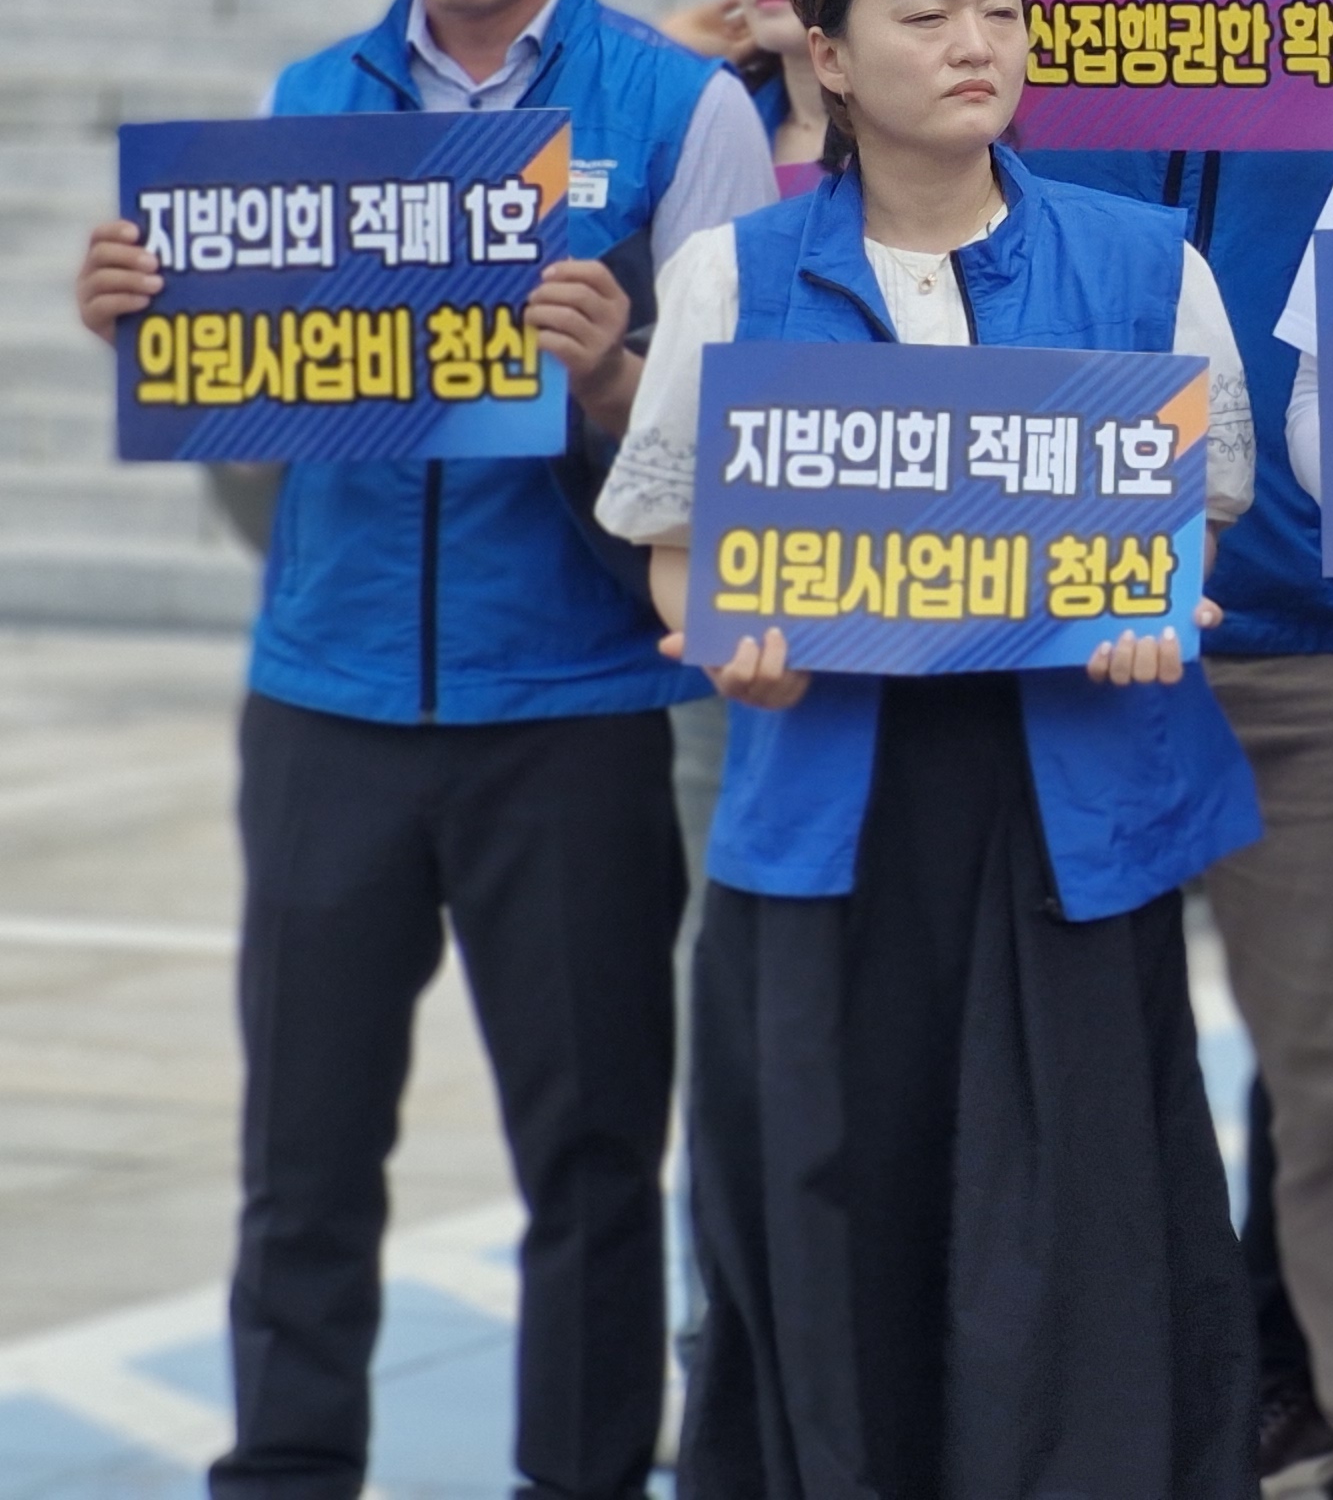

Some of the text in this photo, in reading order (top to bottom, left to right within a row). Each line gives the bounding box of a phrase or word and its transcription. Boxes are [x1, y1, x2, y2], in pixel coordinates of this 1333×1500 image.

[138, 179, 539, 270] 지방의회 적폐 1호
[137, 308, 413, 404] 의원사업비
[725, 408, 1174, 495] 지방의회 적폐 1호
[715, 529, 1173, 619] 의원사업비 청산
